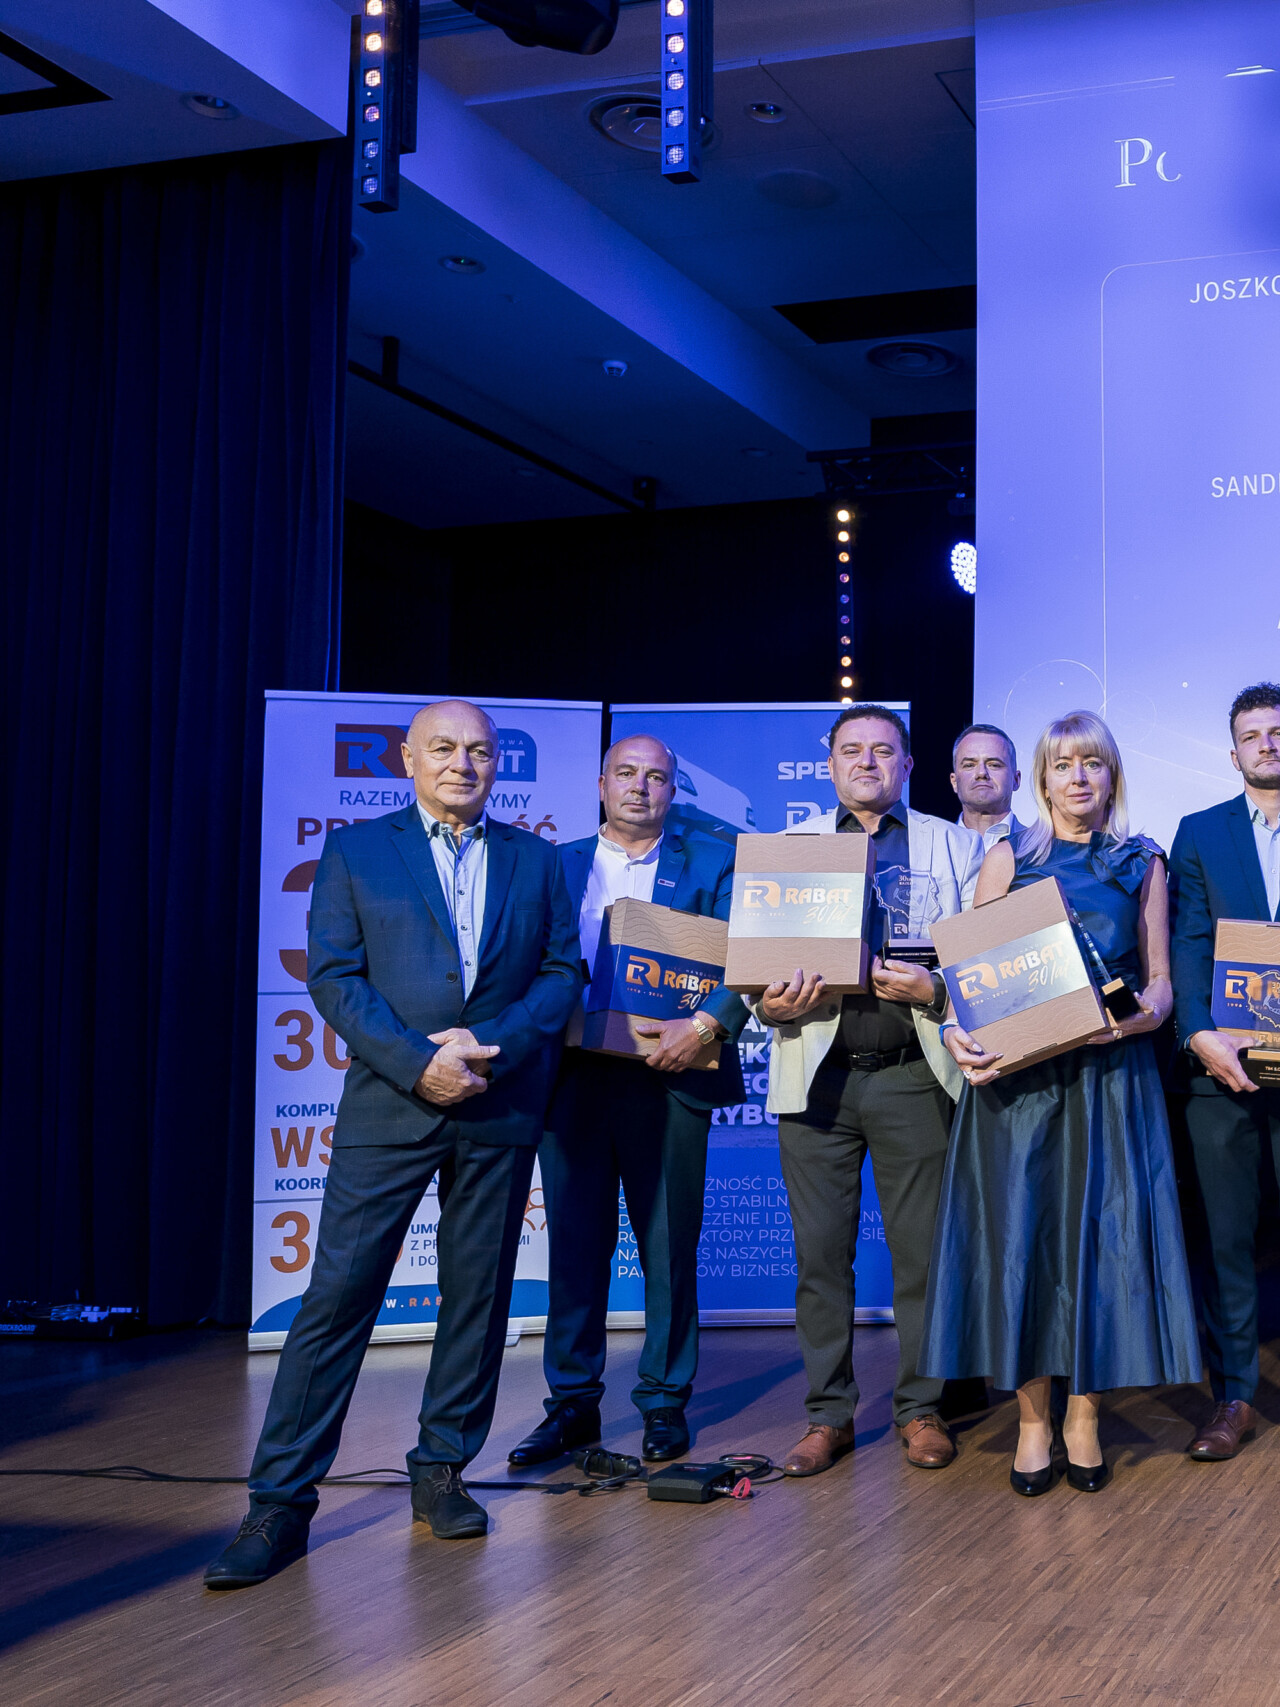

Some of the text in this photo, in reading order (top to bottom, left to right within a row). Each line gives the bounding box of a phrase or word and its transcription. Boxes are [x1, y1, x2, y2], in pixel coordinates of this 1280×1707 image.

[340, 789, 412, 807] RAZEM
[785, 887, 853, 906] RABAT
[998, 941, 1065, 980] RABAT
[715, 1246, 793, 1260] NASZYCH
